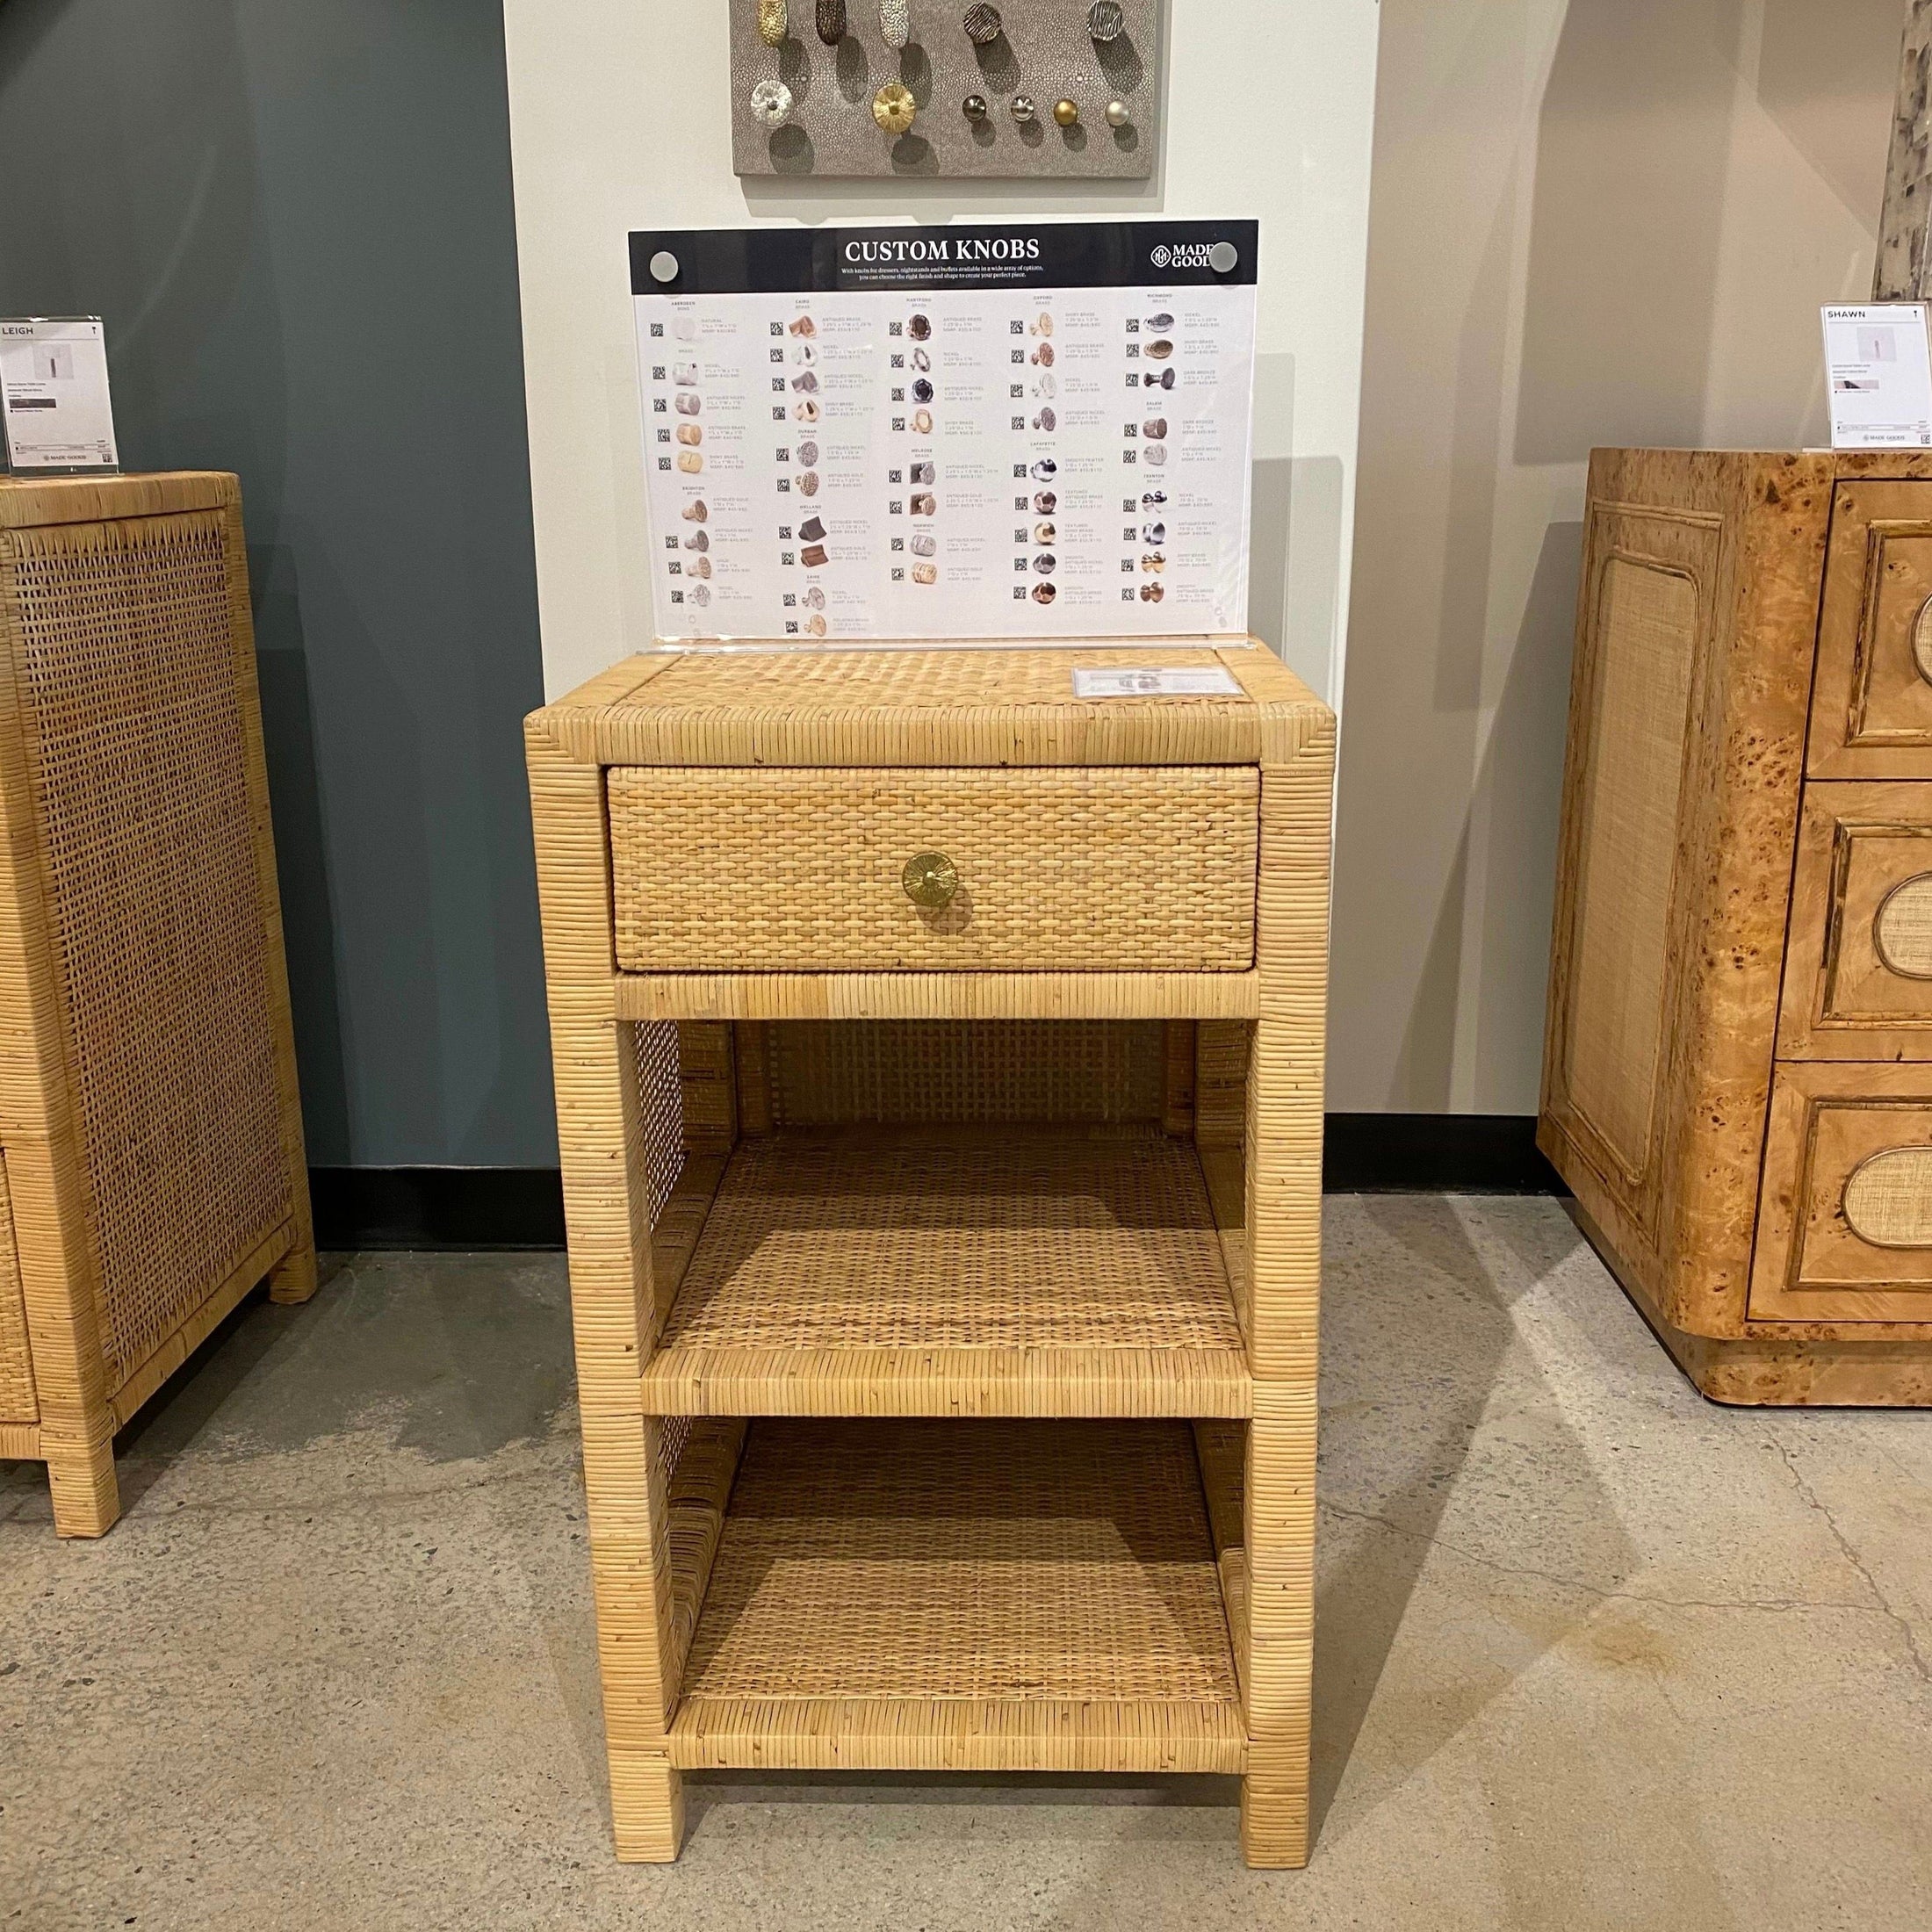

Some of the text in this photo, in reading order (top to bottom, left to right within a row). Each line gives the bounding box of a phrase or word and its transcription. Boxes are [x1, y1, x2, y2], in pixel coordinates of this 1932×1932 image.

[845, 239, 1041, 262] CUSTOM KNOBS
[1171, 256, 1211, 267] GOOD
